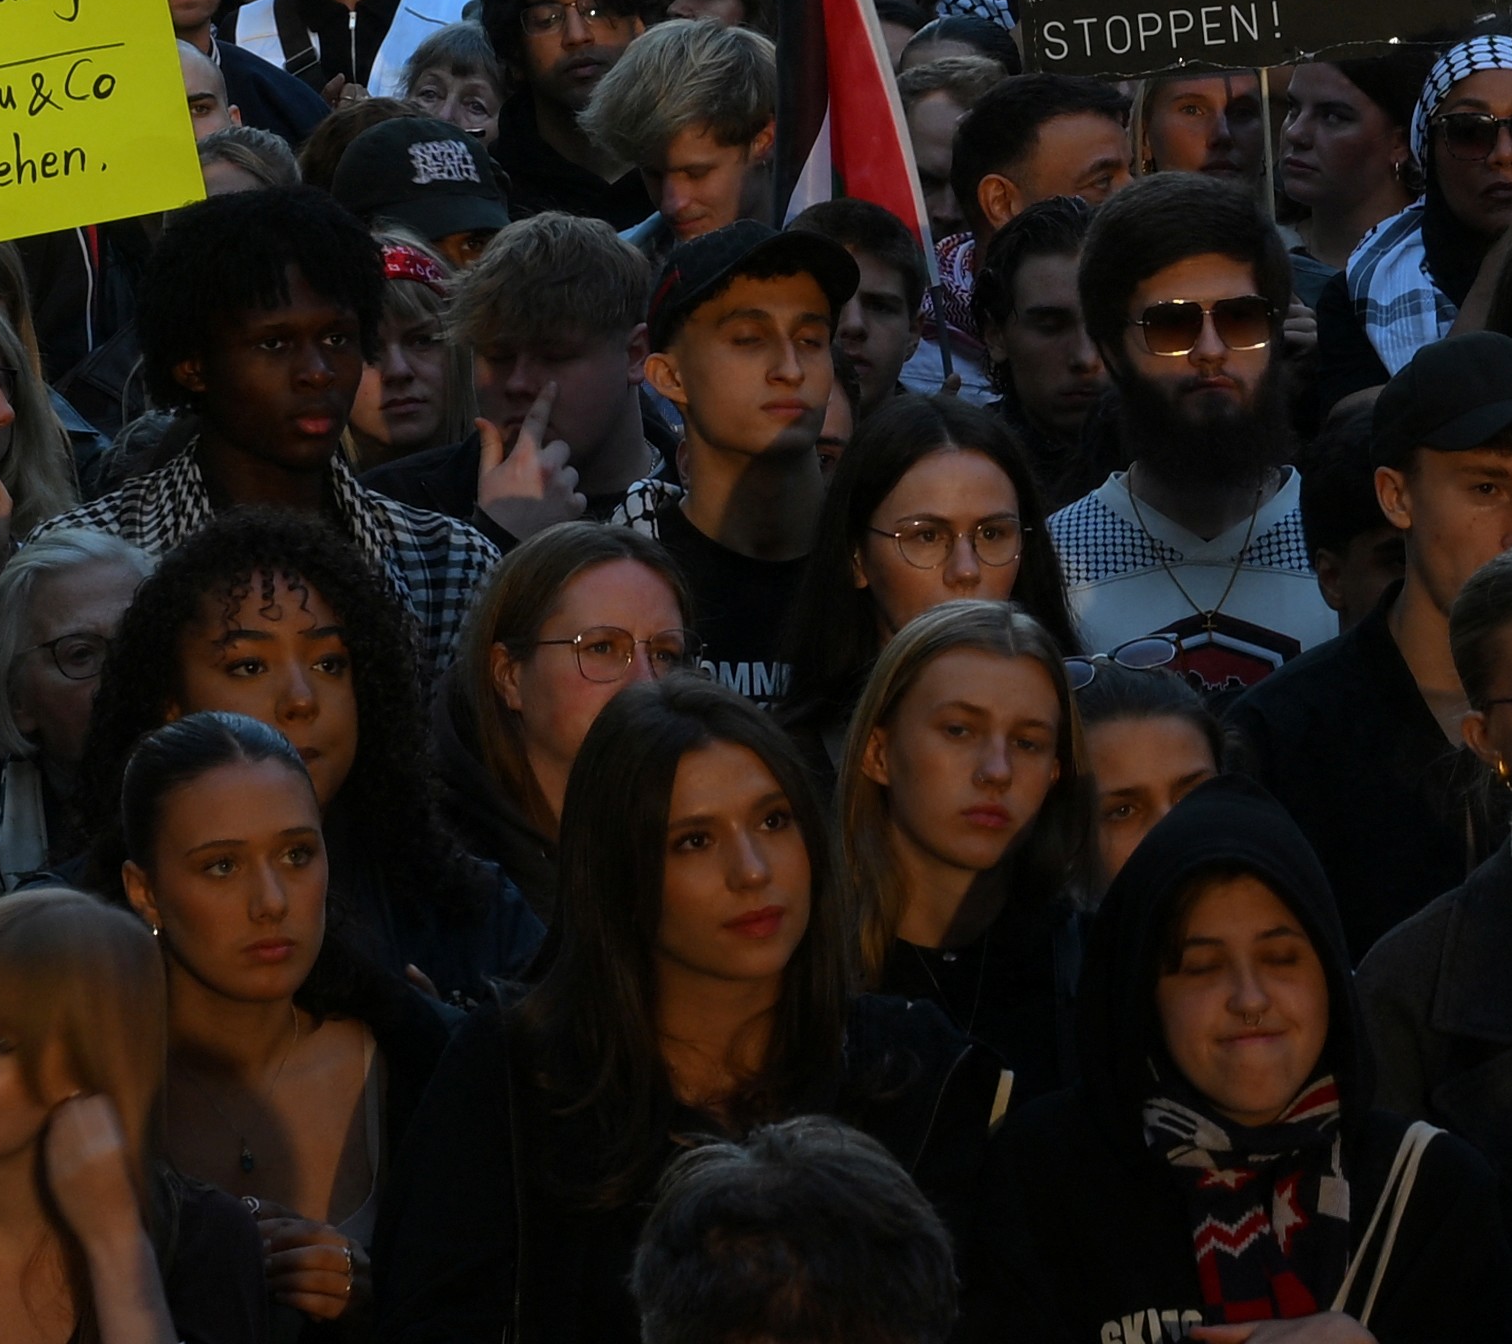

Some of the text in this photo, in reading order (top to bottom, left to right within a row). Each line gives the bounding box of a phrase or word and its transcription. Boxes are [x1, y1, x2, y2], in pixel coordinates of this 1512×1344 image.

[1042, 0, 1282, 62] STOPPEN!
[26, 72, 61, 116] &
[64, 58, 117, 102] Co
